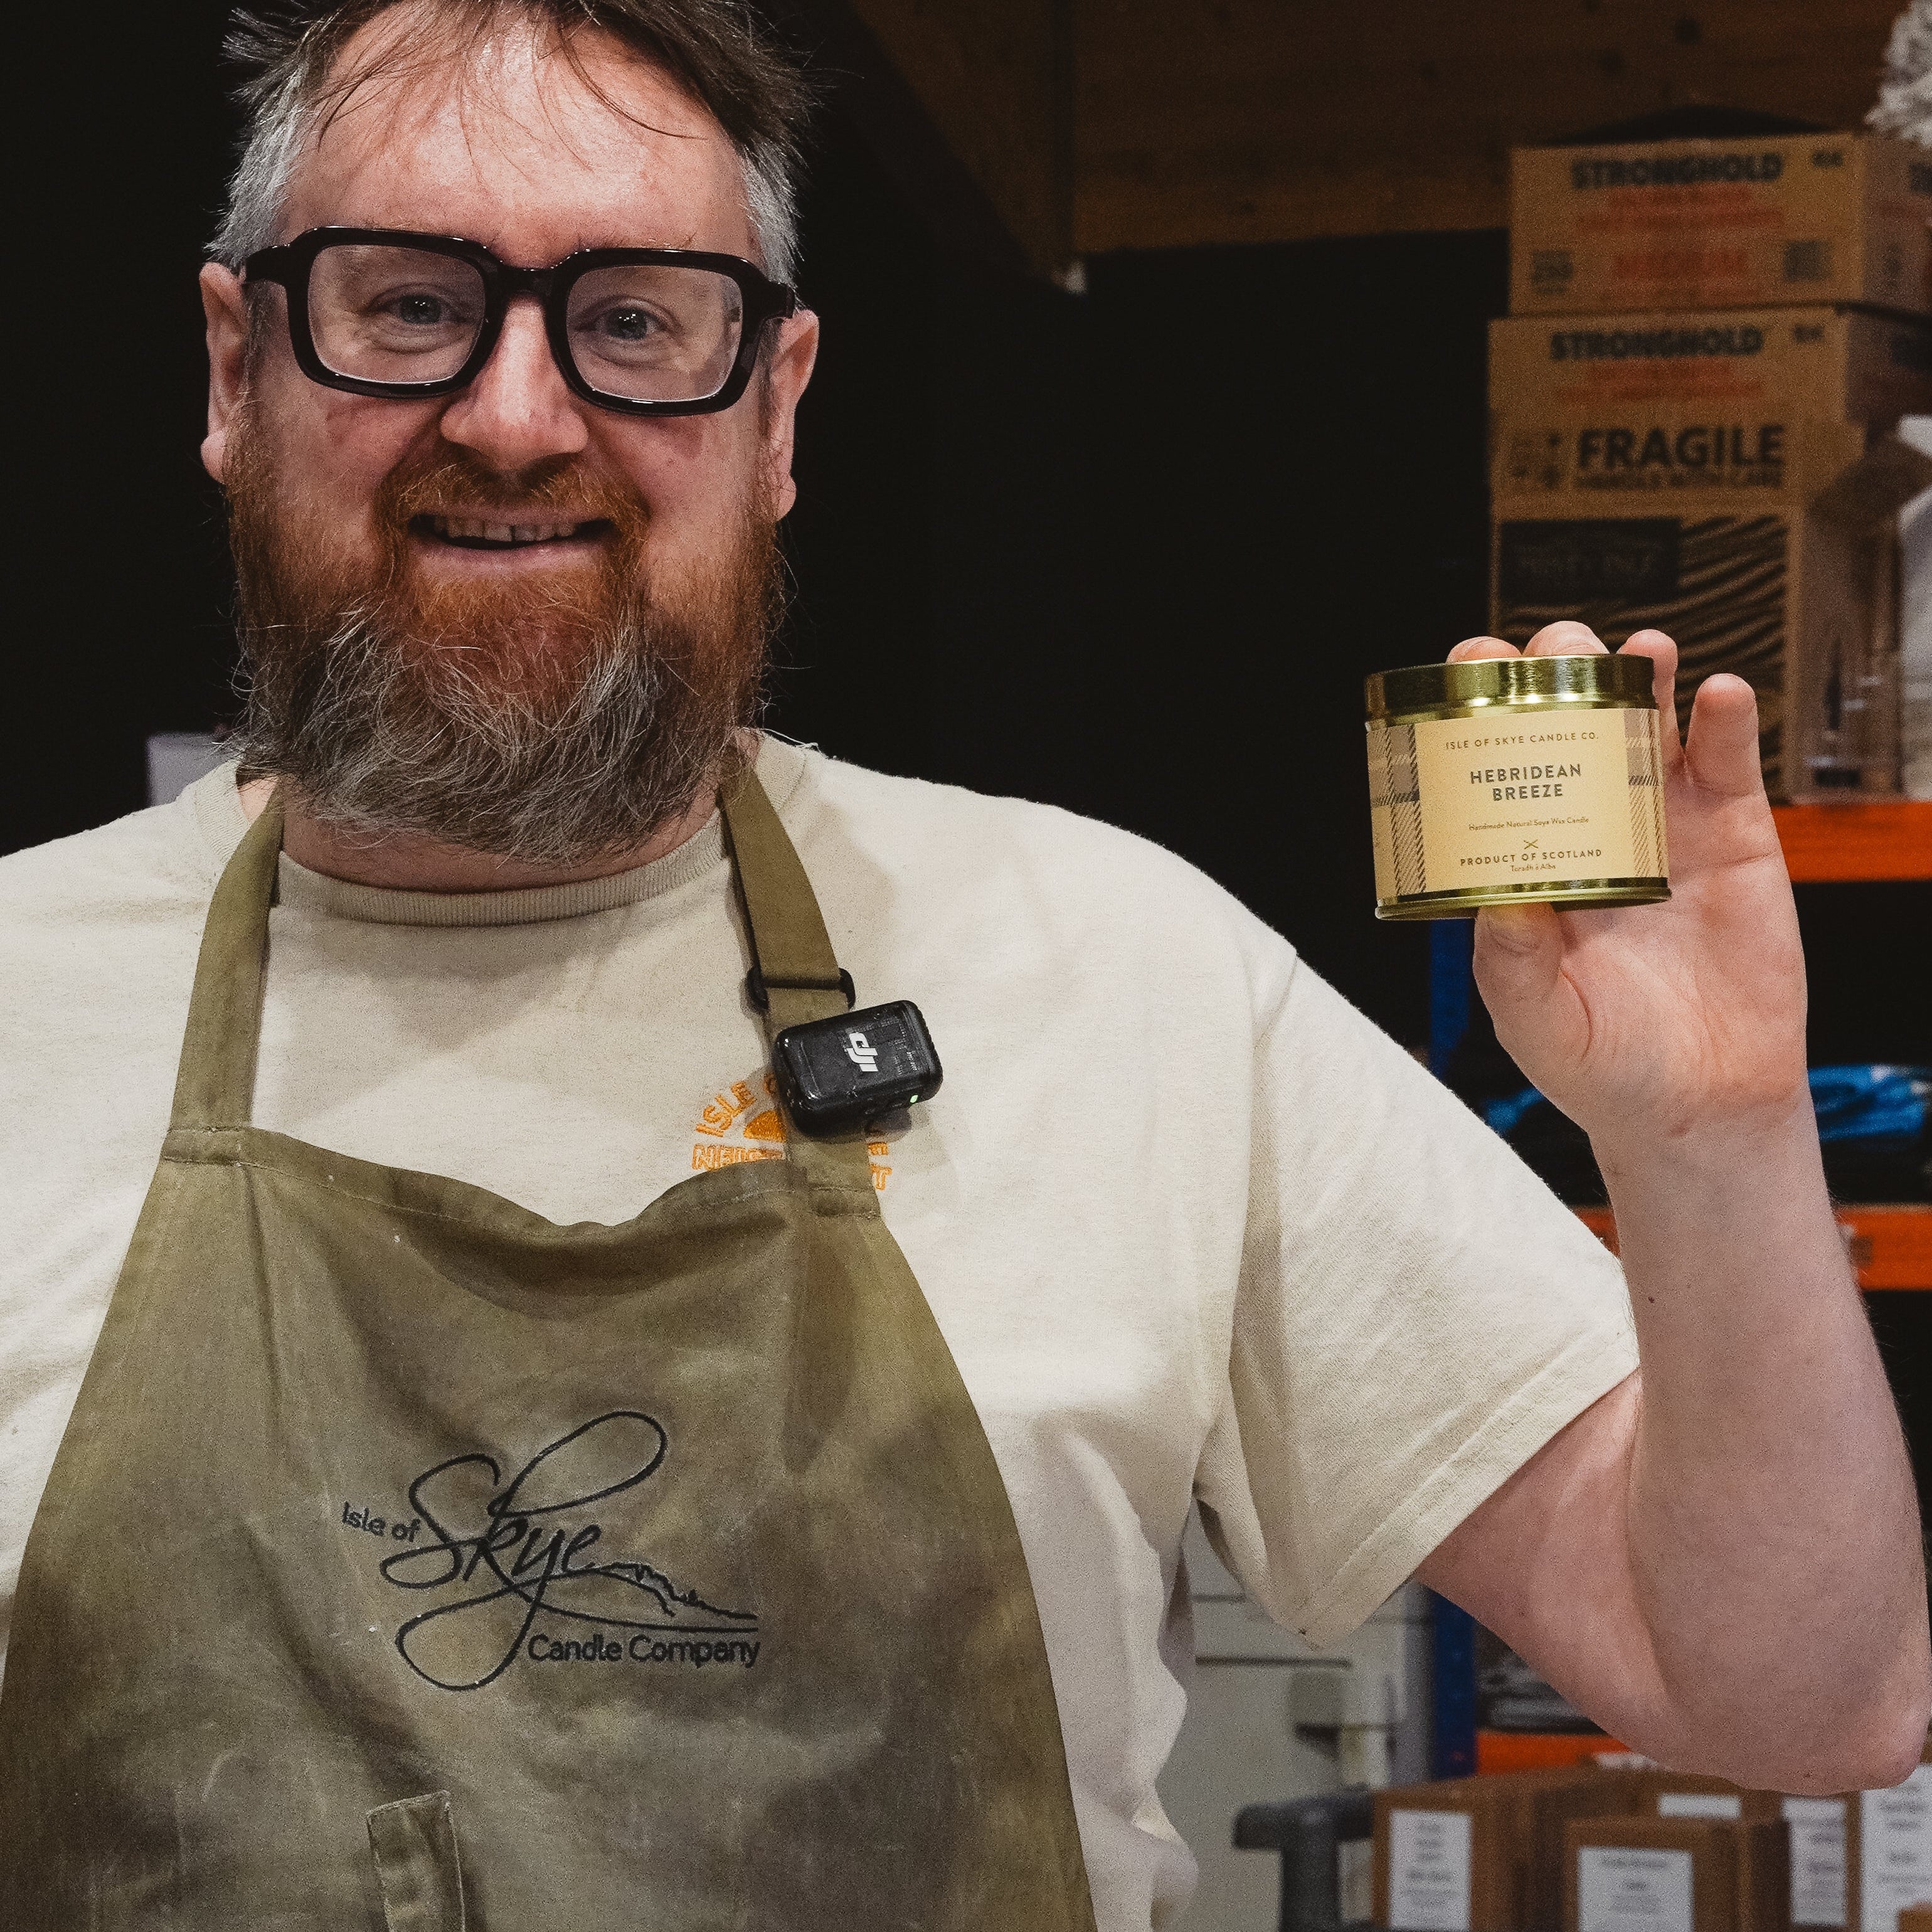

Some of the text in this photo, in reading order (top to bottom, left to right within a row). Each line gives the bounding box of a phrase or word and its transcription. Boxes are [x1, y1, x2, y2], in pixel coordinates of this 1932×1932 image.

[1571, 153, 1784, 189] STRONGHOLD
[1550, 327, 1763, 361] STRONGHOLD
[1578, 425, 1786, 468] FRAGILE
[1446, 741, 1469, 750] ISLE
[1475, 738, 1489, 747] OF
[1495, 735, 1524, 745] SKYE
[1530, 732, 1576, 743] CANDLE
[1470, 763, 1581, 784] HEBRIDEAN
[1492, 783, 1563, 801] BREEZE
[1506, 820, 1532, 829] Natural
[1567, 816, 1589, 824] Candle
[1460, 849, 1602, 866] PRODUCT OF SCOTLAND
[695, 1080, 757, 1138] ISLE
[342, 1411, 667, 1691] Isle of Skye
[528, 1633, 761, 1669] Candle Company
